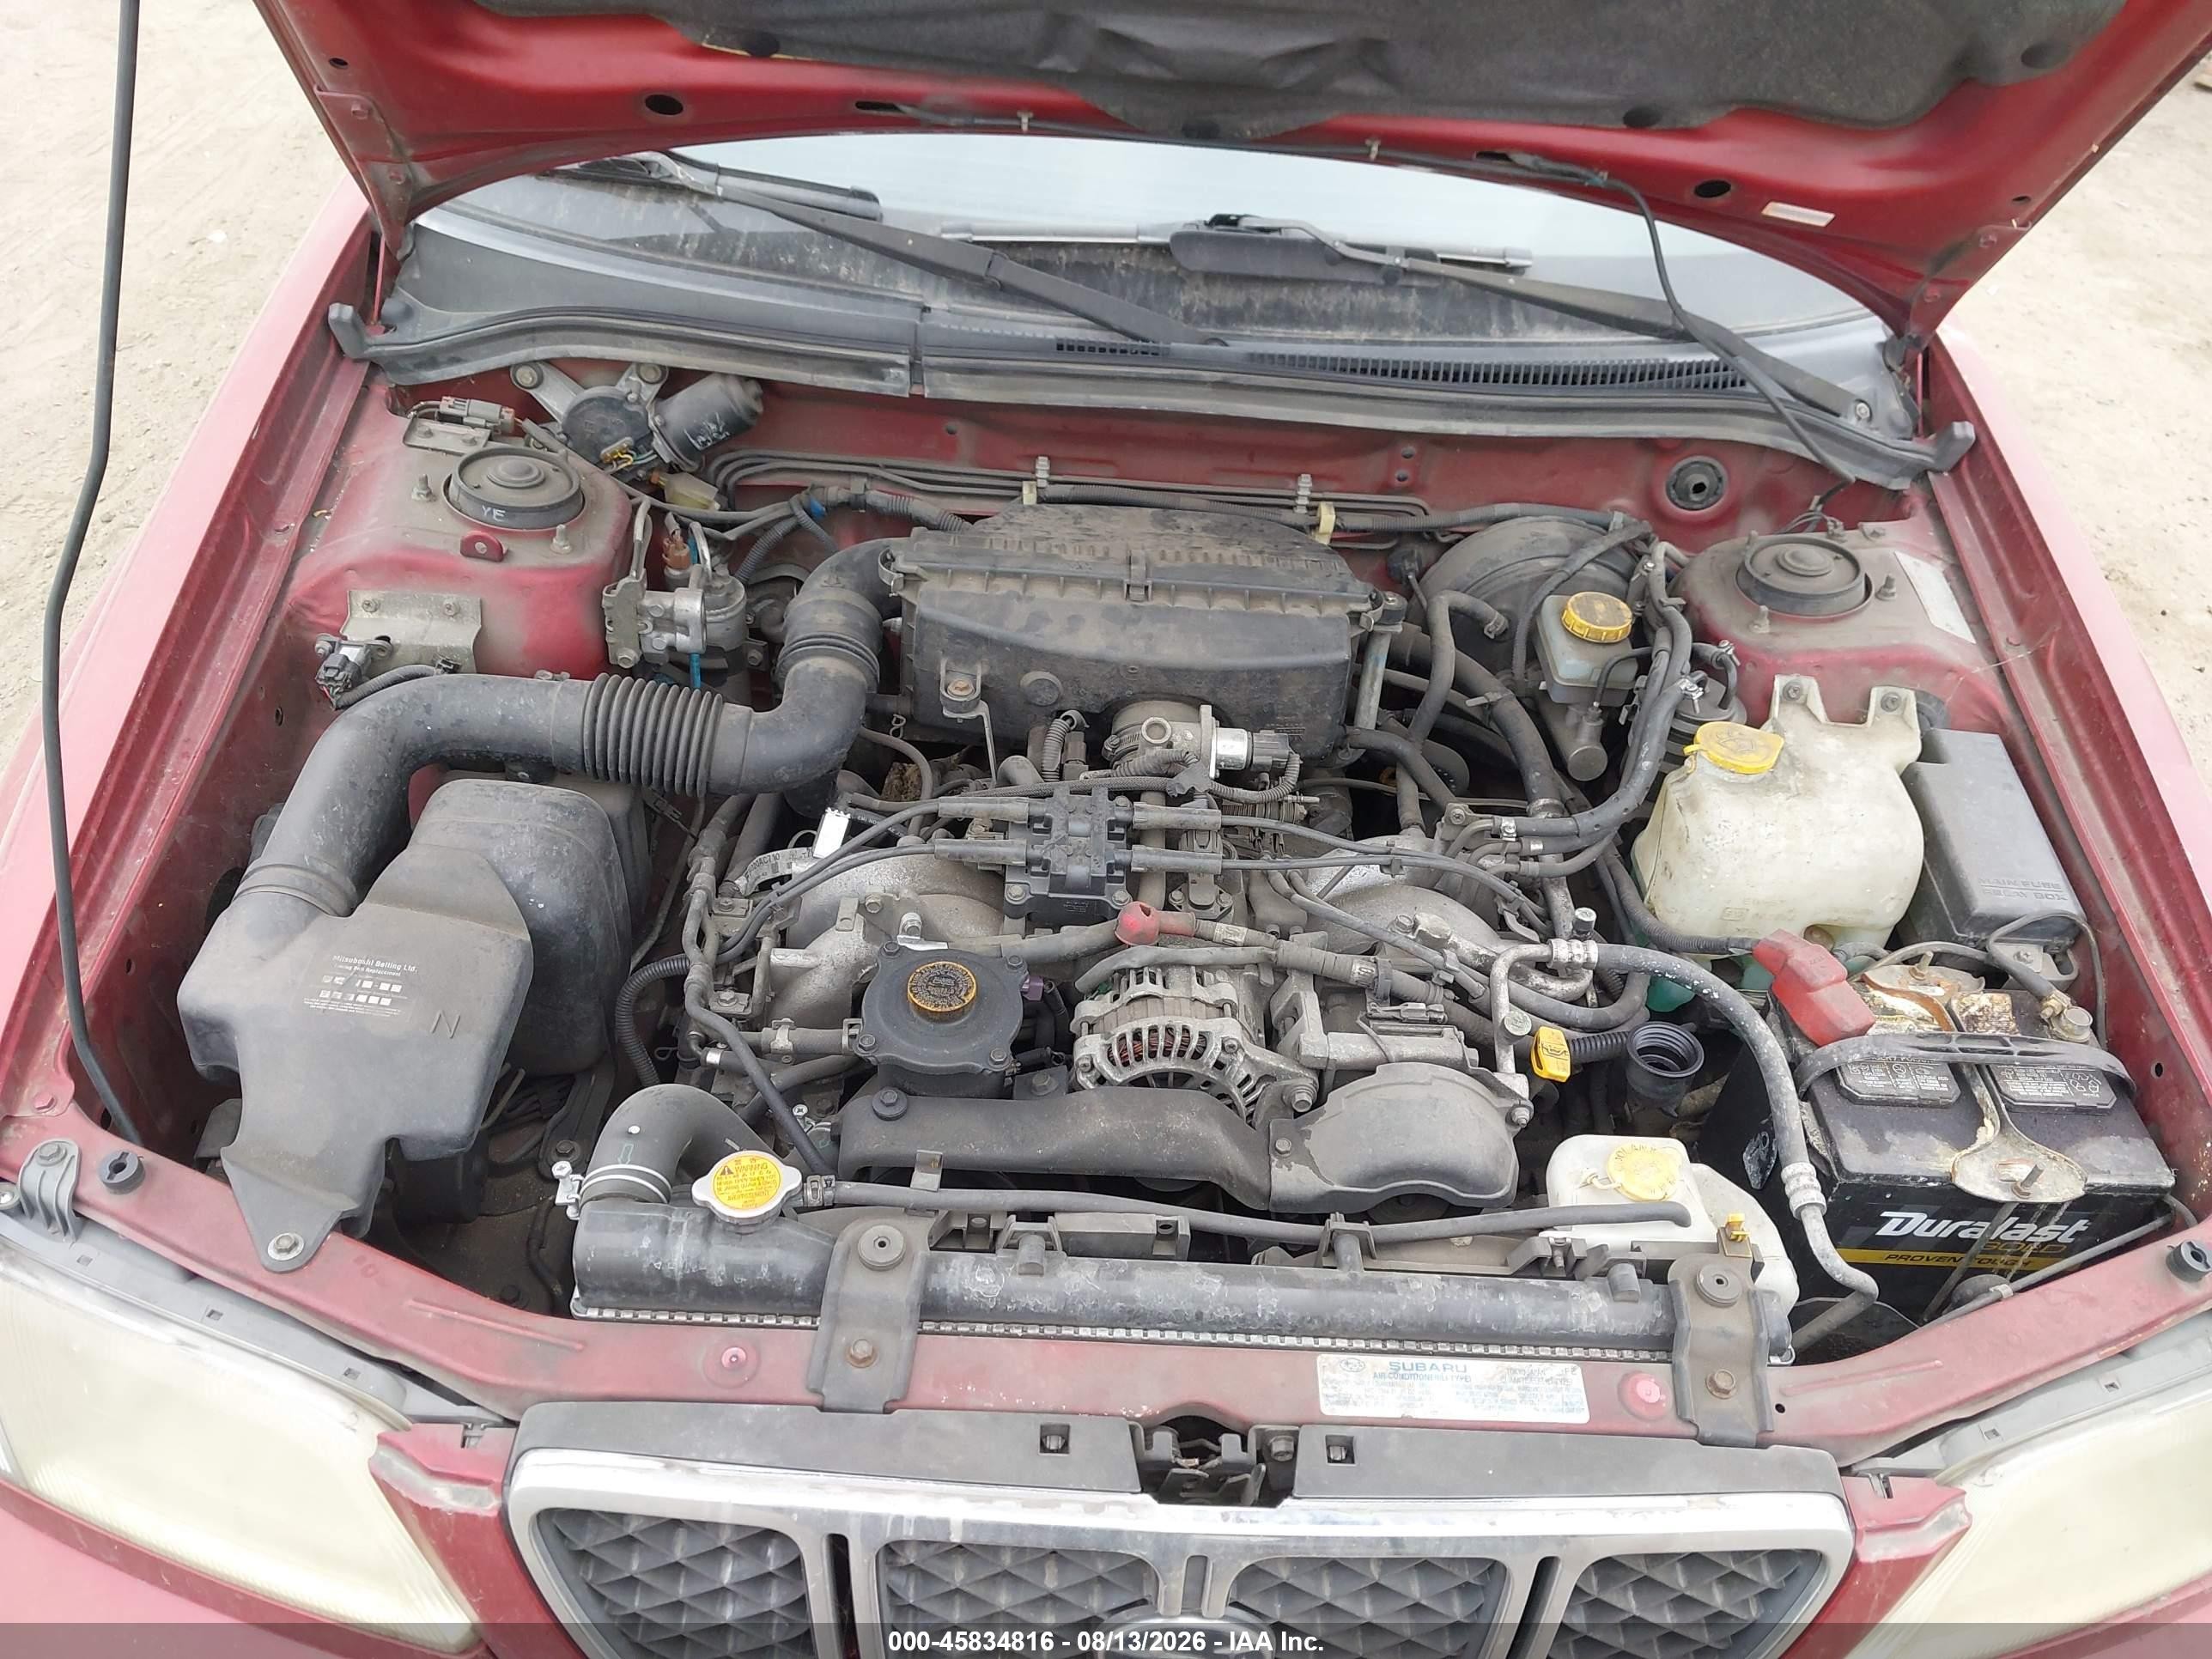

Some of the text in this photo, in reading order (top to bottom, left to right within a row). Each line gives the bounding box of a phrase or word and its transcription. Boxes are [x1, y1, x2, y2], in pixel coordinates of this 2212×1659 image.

[375, 960, 402, 971] Belting
[404, 963, 418, 973] Ltd.
[735, 1163, 769, 1173] WARNING
[1875, 1211, 2090, 1243] Duralast
[1884, 1254, 2031, 1267] PROVEN OUGH
[1389, 1361, 1468, 1373] SUBARU
